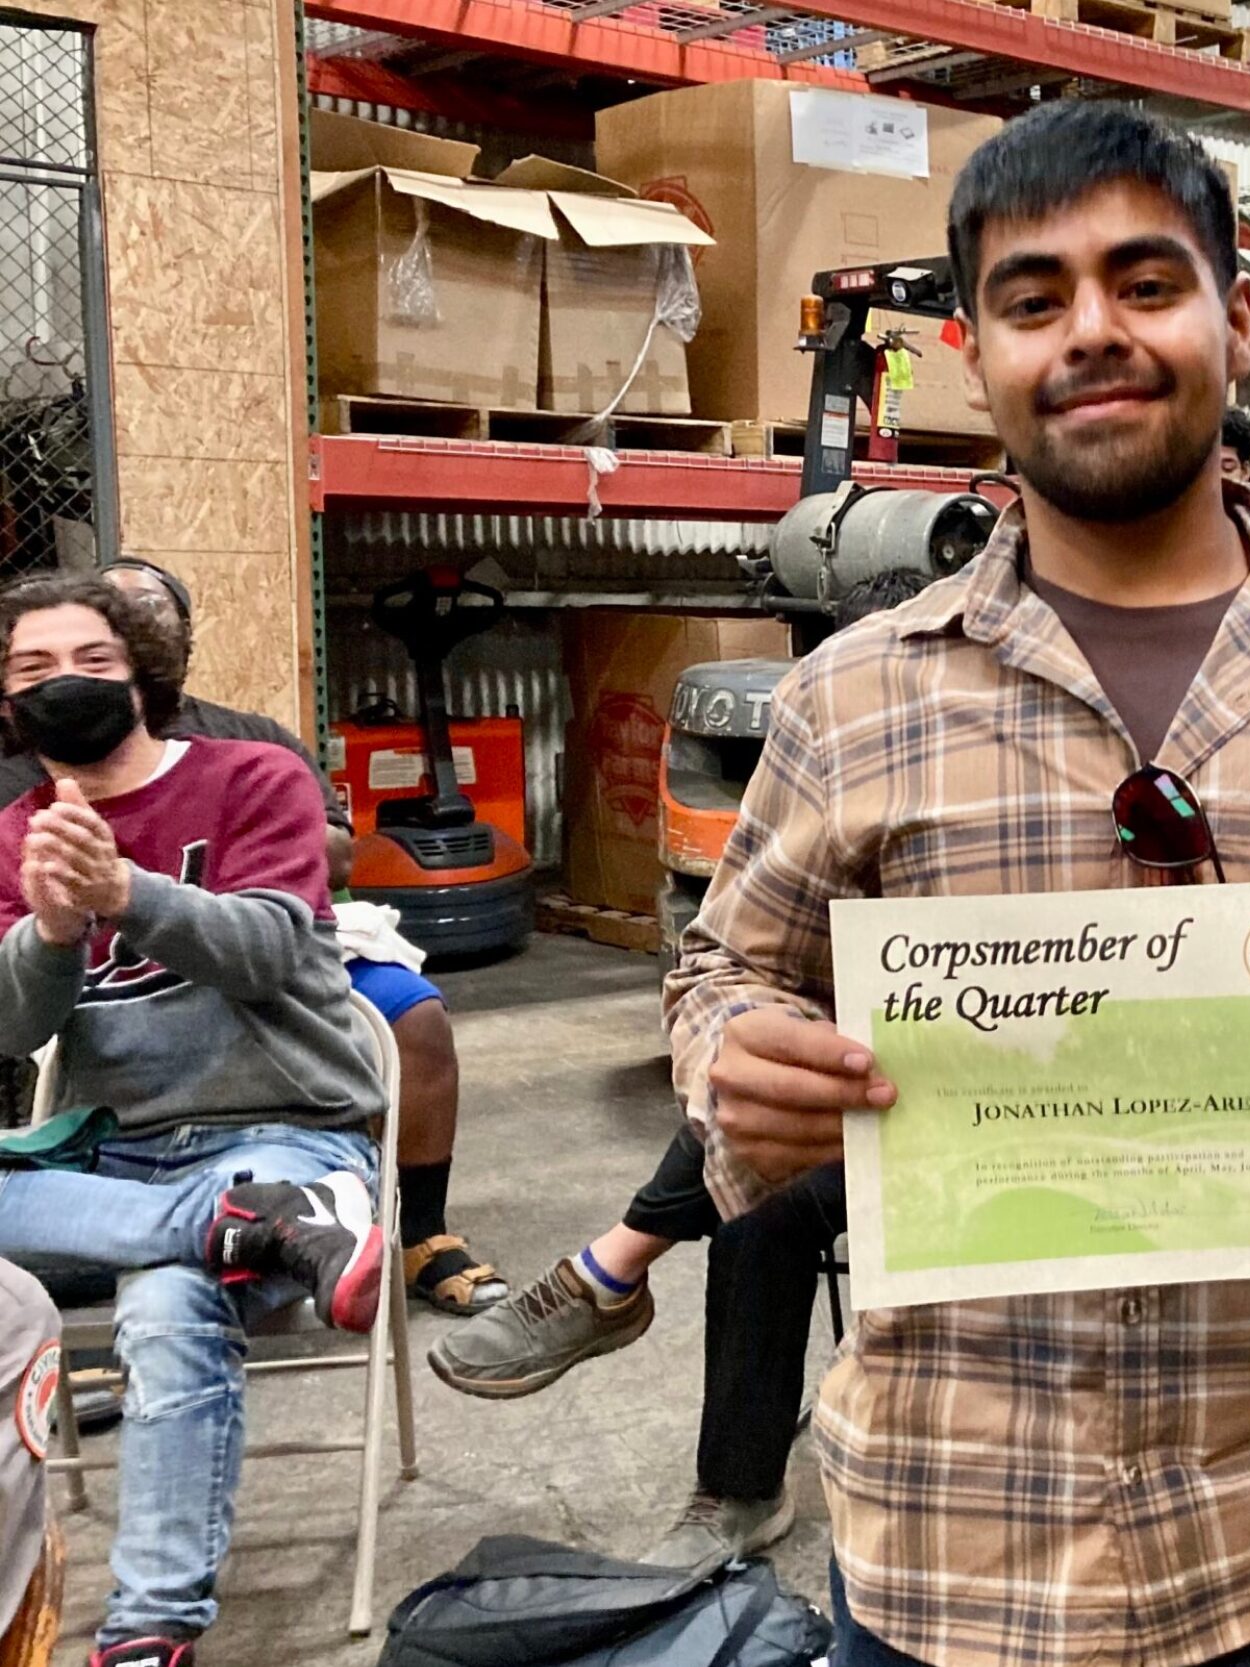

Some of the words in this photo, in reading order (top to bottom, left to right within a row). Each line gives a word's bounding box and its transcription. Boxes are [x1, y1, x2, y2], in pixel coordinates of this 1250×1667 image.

[880, 922, 1138, 980] Corpsmember
[1146, 917, 1194, 972] of
[884, 981, 943, 1022] the
[955, 985, 1110, 1031] Quarter
[972, 1100, 1104, 1127] JONATHAN
[976, 1161, 988, 1172] In
[992, 1158, 1056, 1171] recognition
[1060, 1156, 1072, 1167] of
[1077, 1153, 1143, 1166] outstanding
[1148, 1151, 1221, 1164] participation
[1224, 1149, 1245, 1160] and
[976, 1174, 1045, 1187] performance
[1050, 1170, 1087, 1182] during
[1091, 1168, 1109, 1178] the
[1113, 1167, 1154, 1178] months
[1158, 1165, 1169, 1175] of
